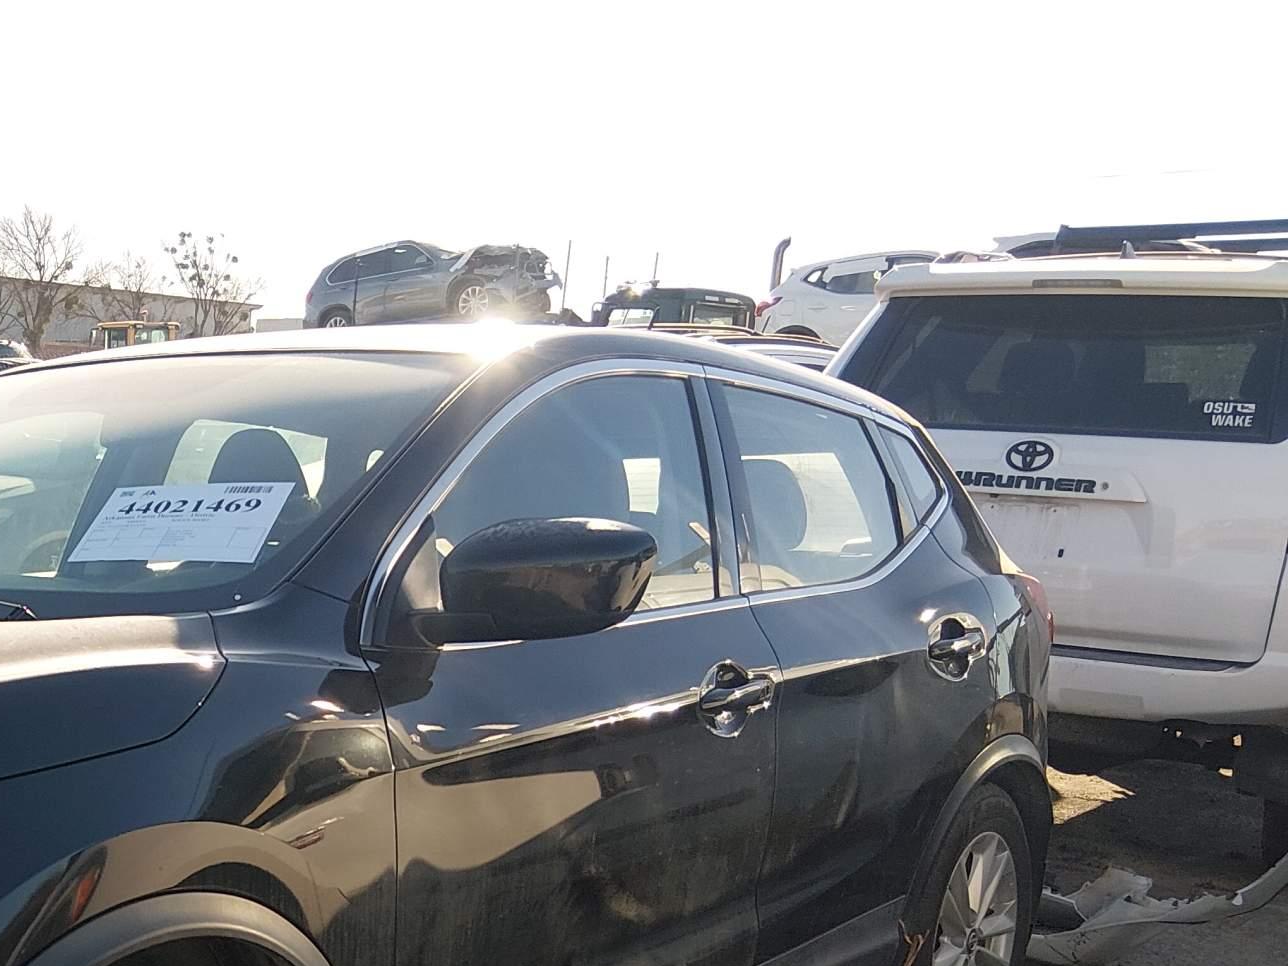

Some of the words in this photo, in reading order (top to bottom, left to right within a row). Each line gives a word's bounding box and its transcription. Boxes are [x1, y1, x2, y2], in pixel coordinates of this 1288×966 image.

[1203, 401, 1233, 414] OSU
[1211, 414, 1254, 427] WAKE
[955, 470, 1097, 494] 4RUNNER
[118, 498, 262, 515] 44021469
